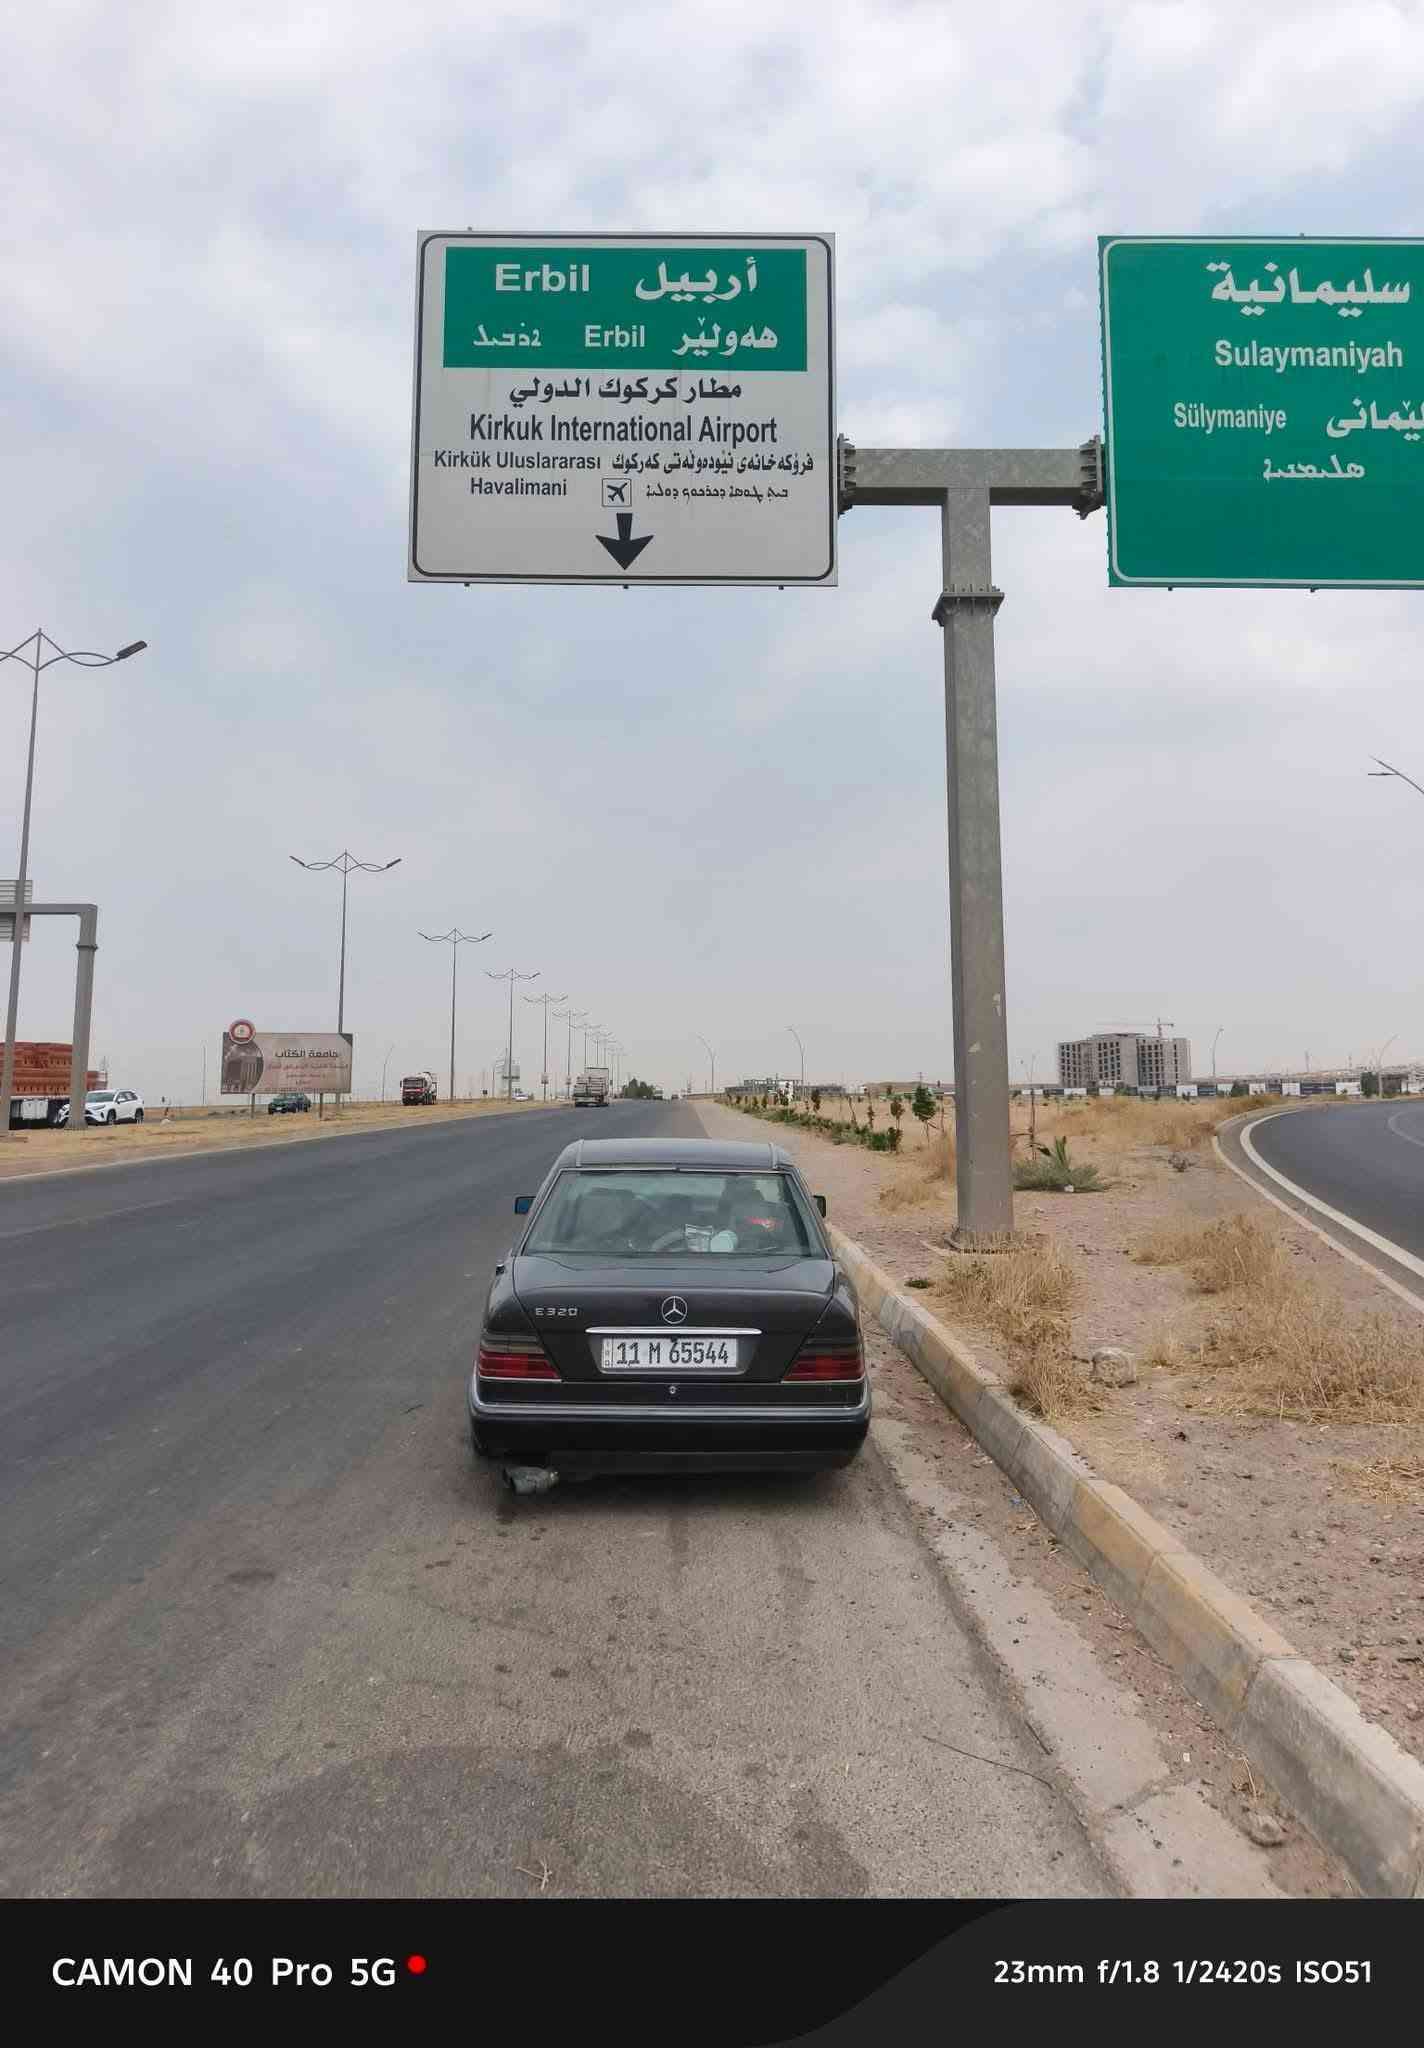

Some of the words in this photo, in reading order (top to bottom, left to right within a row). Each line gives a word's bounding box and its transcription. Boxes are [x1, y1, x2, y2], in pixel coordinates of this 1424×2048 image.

[496, 264, 589, 291] Erbil
[636, 257, 757, 303] أربيل
[1206, 262, 1409, 317] سليمانية
[585, 325, 644, 347] Erbil
[1216, 340, 1402, 373] Sulaymaniyah
[510, 377, 590, 408] الدولي
[599, 377, 677, 404] كركوك
[683, 378, 741, 403] مطار
[471, 414, 543, 440] Kirkuk
[552, 415, 691, 441] International
[699, 416, 777, 449] Airport
[1174, 403, 1286, 434] Sülymaniye
[435, 450, 490, 467] Kirkük
[497, 452, 600, 469] Uluslararası
[471, 477, 566, 496] Havalimani
[536, 1308, 577, 1316] E320
[617, 1342, 639, 1361] 11
[649, 1342, 660, 1364] M
[669, 1341, 728, 1364] 65544
